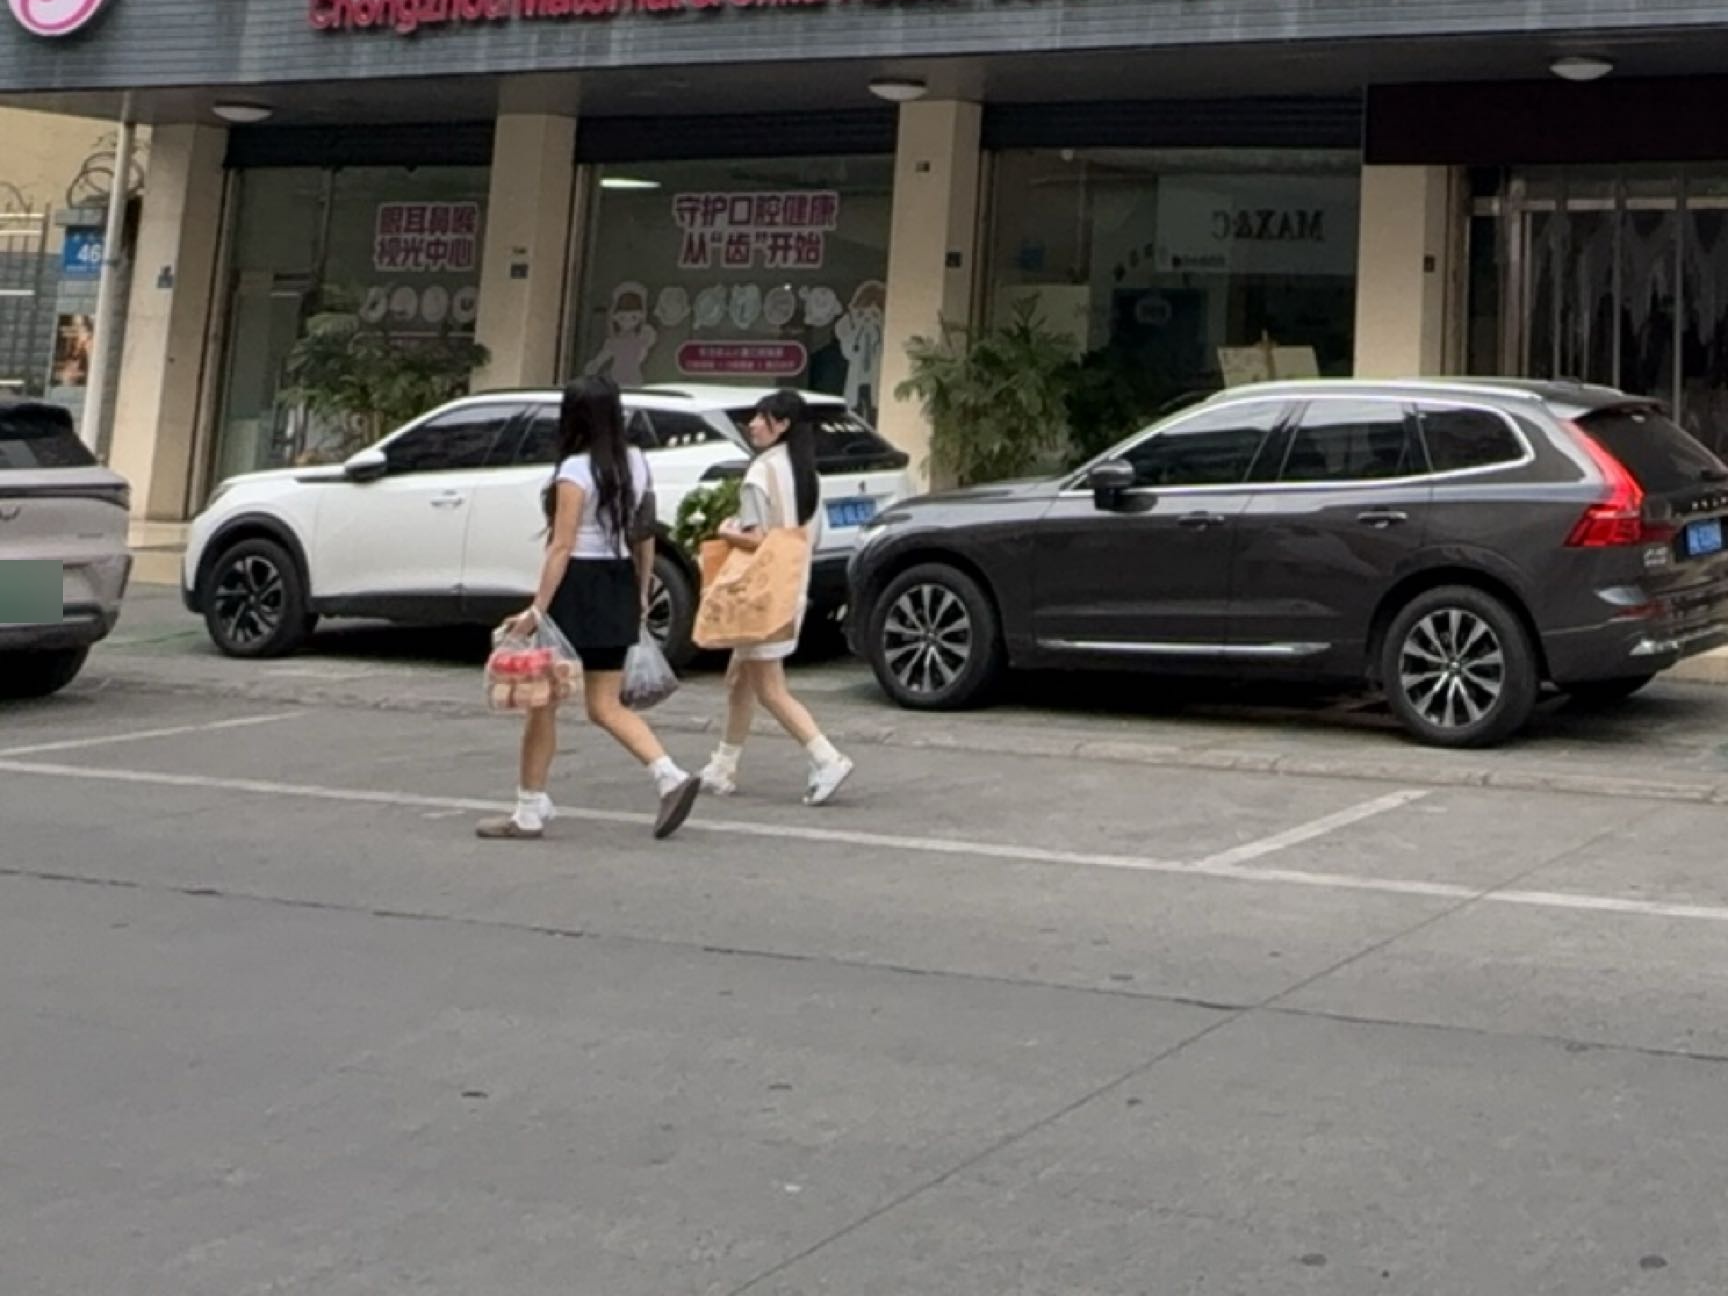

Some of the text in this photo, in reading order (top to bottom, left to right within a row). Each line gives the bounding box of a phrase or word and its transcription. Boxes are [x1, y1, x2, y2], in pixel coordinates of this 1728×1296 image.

[675, 190, 837, 228] 守护口腔健康
